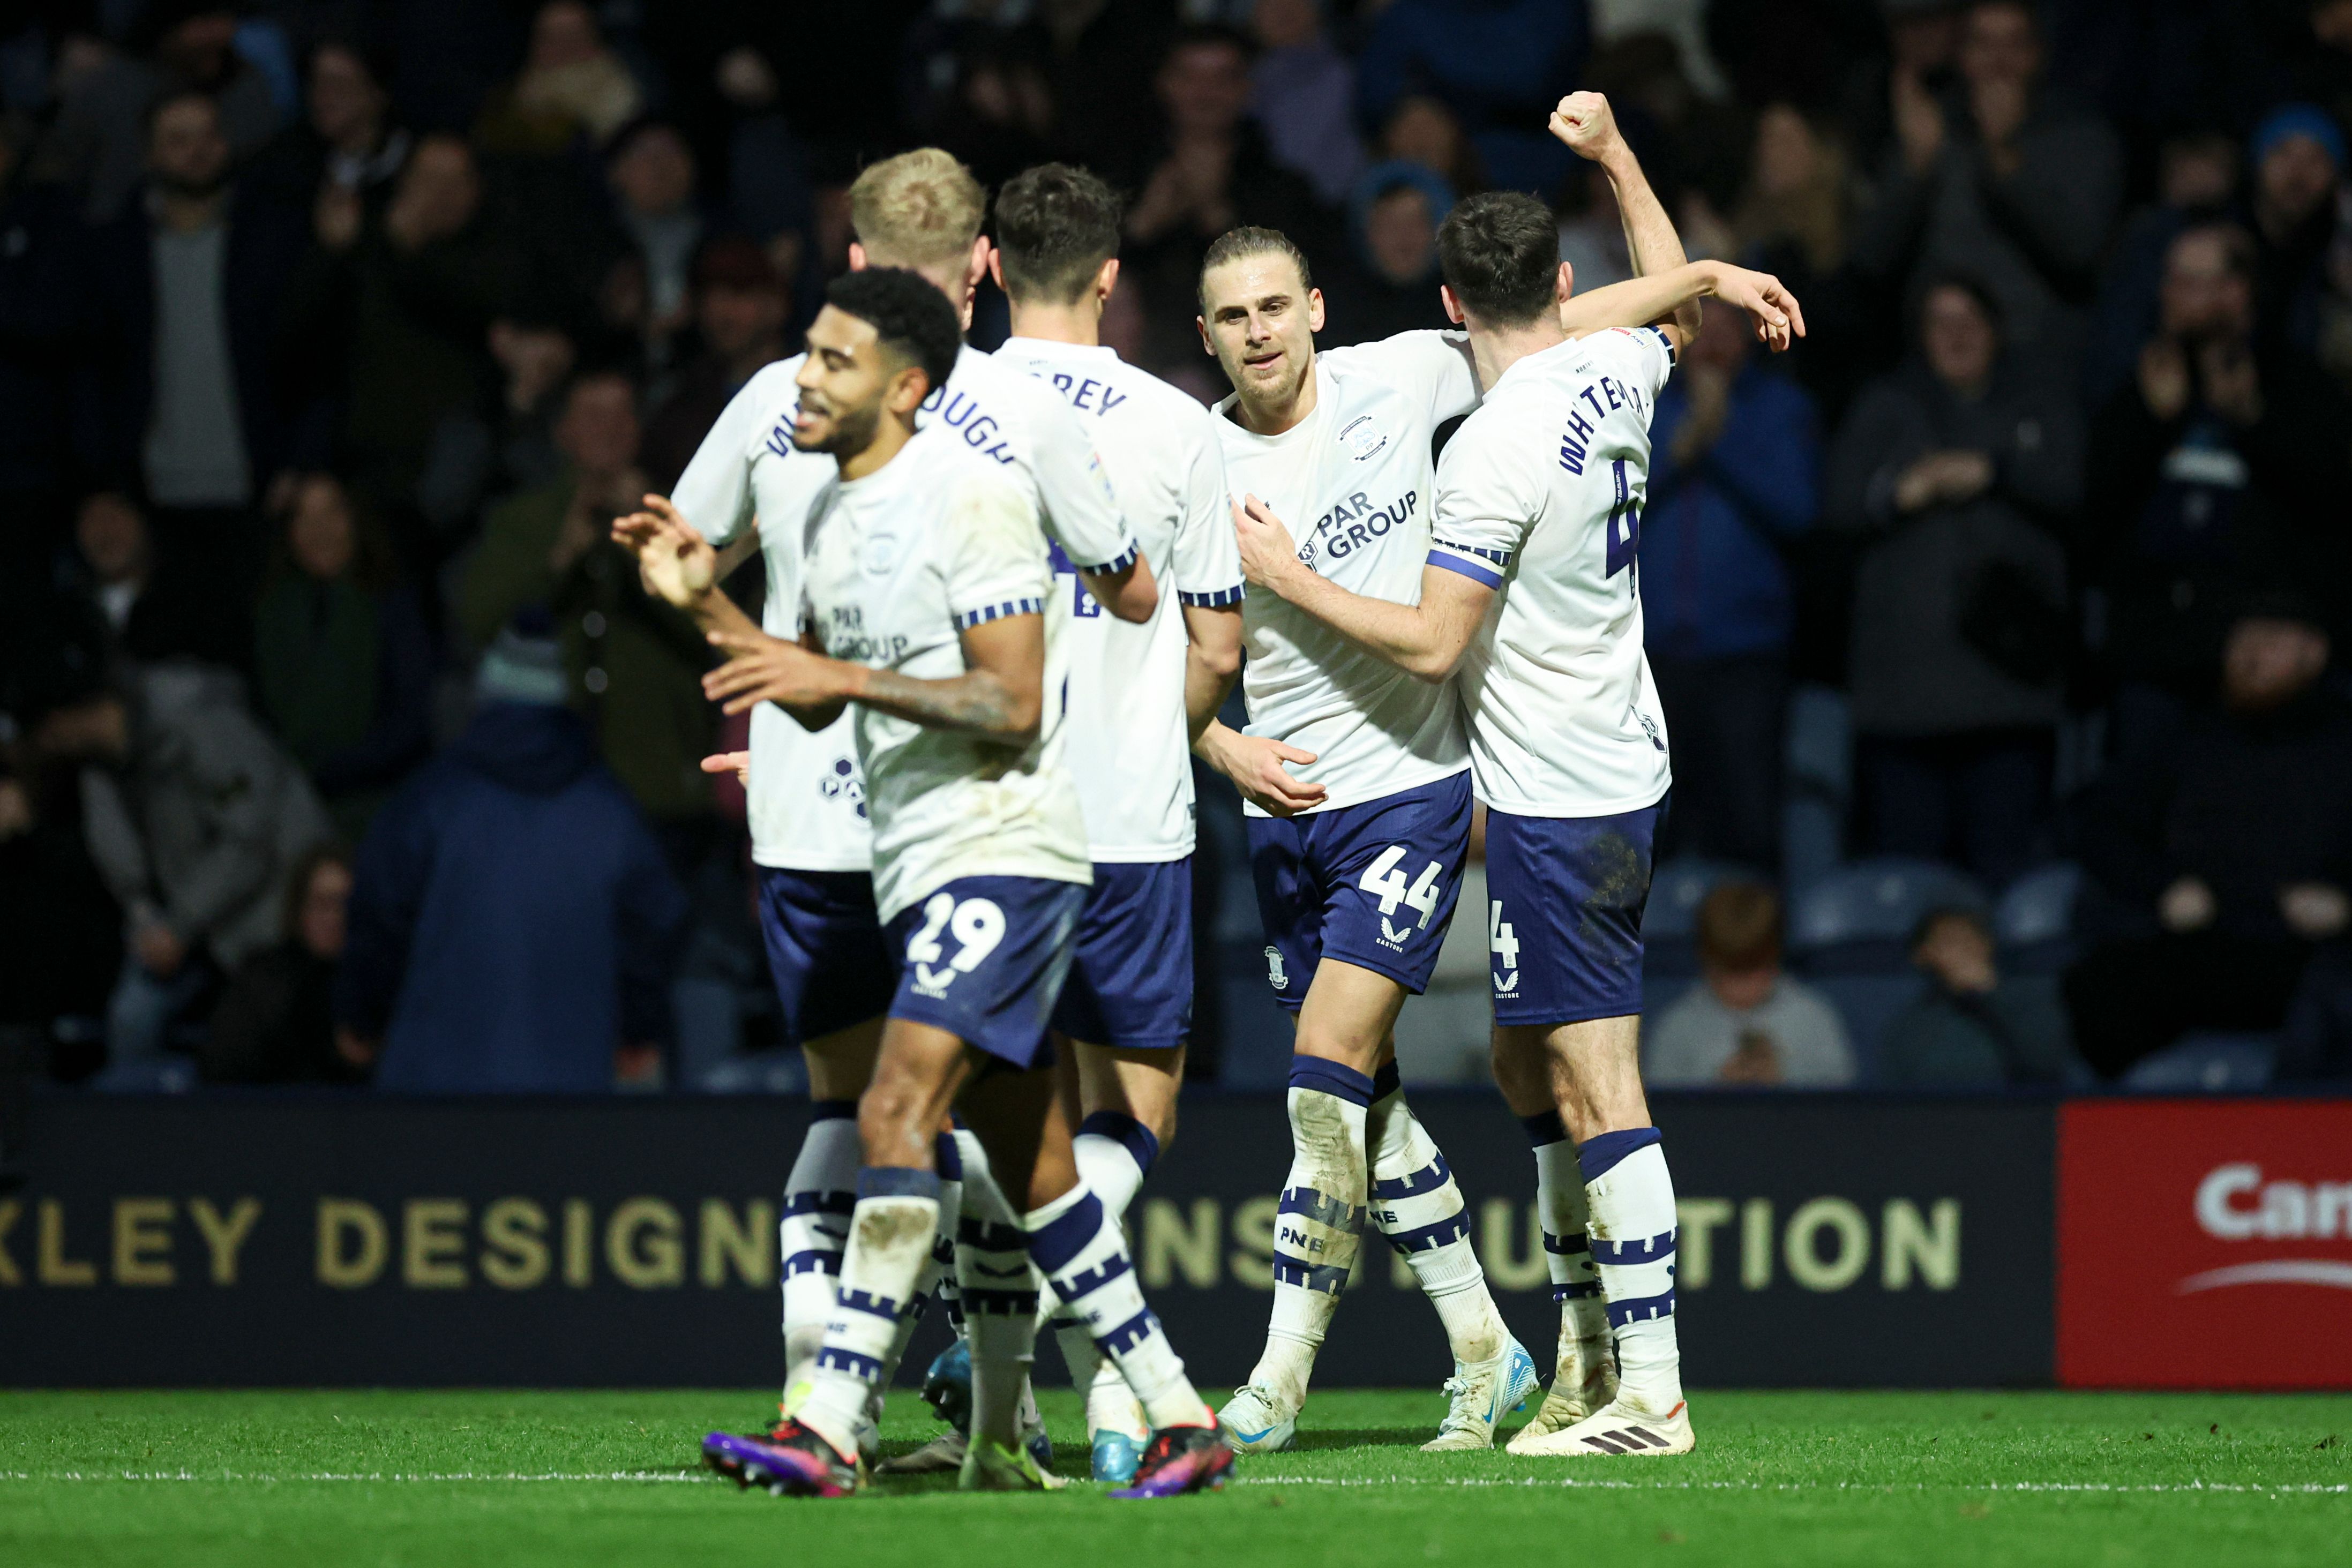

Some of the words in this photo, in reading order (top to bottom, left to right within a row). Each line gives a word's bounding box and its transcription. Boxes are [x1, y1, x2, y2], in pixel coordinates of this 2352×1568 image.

[1317, 492, 1375, 538] PAR
[1327, 490, 1417, 558] GROUP
[1359, 845, 1442, 930] 44
[907, 892, 1006, 973] 29
[1376, 937, 1403, 953] CASTORE
[1490, 900, 1519, 969] 4
[315, 1196, 778, 1287] DESIGN
[1280, 1226, 1324, 1254] PNE
